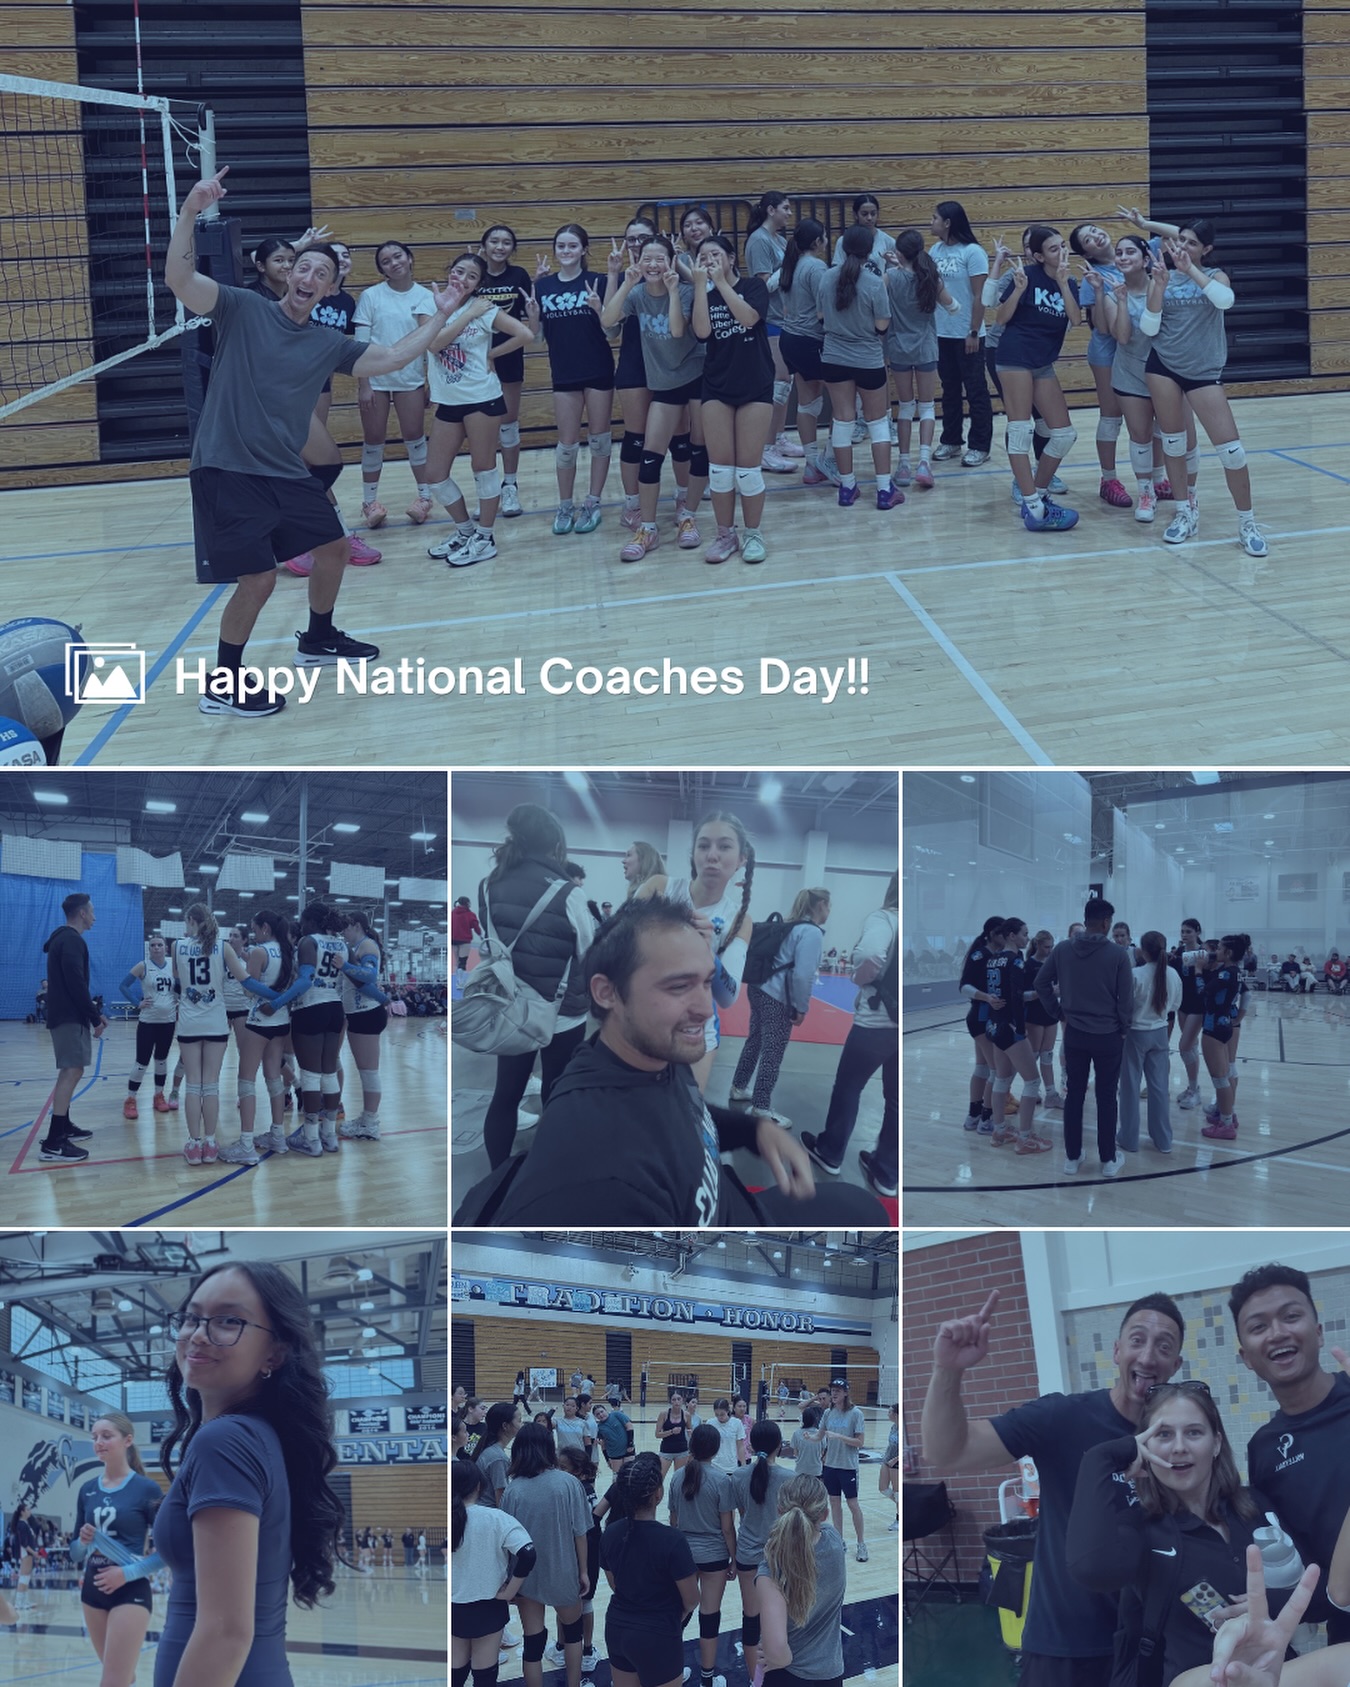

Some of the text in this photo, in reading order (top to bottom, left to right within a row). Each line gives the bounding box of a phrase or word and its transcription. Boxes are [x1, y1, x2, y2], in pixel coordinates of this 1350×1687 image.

[1035, 287, 1065, 311] KO
[3, 750, 41, 766] ASA
[188, 957, 211, 985] 13
[156, 977, 171, 992] 24
[721, 1307, 815, 1334] HONOR
[335, 1438, 447, 1463] ENTA
[93, 1506, 117, 1536] 12
